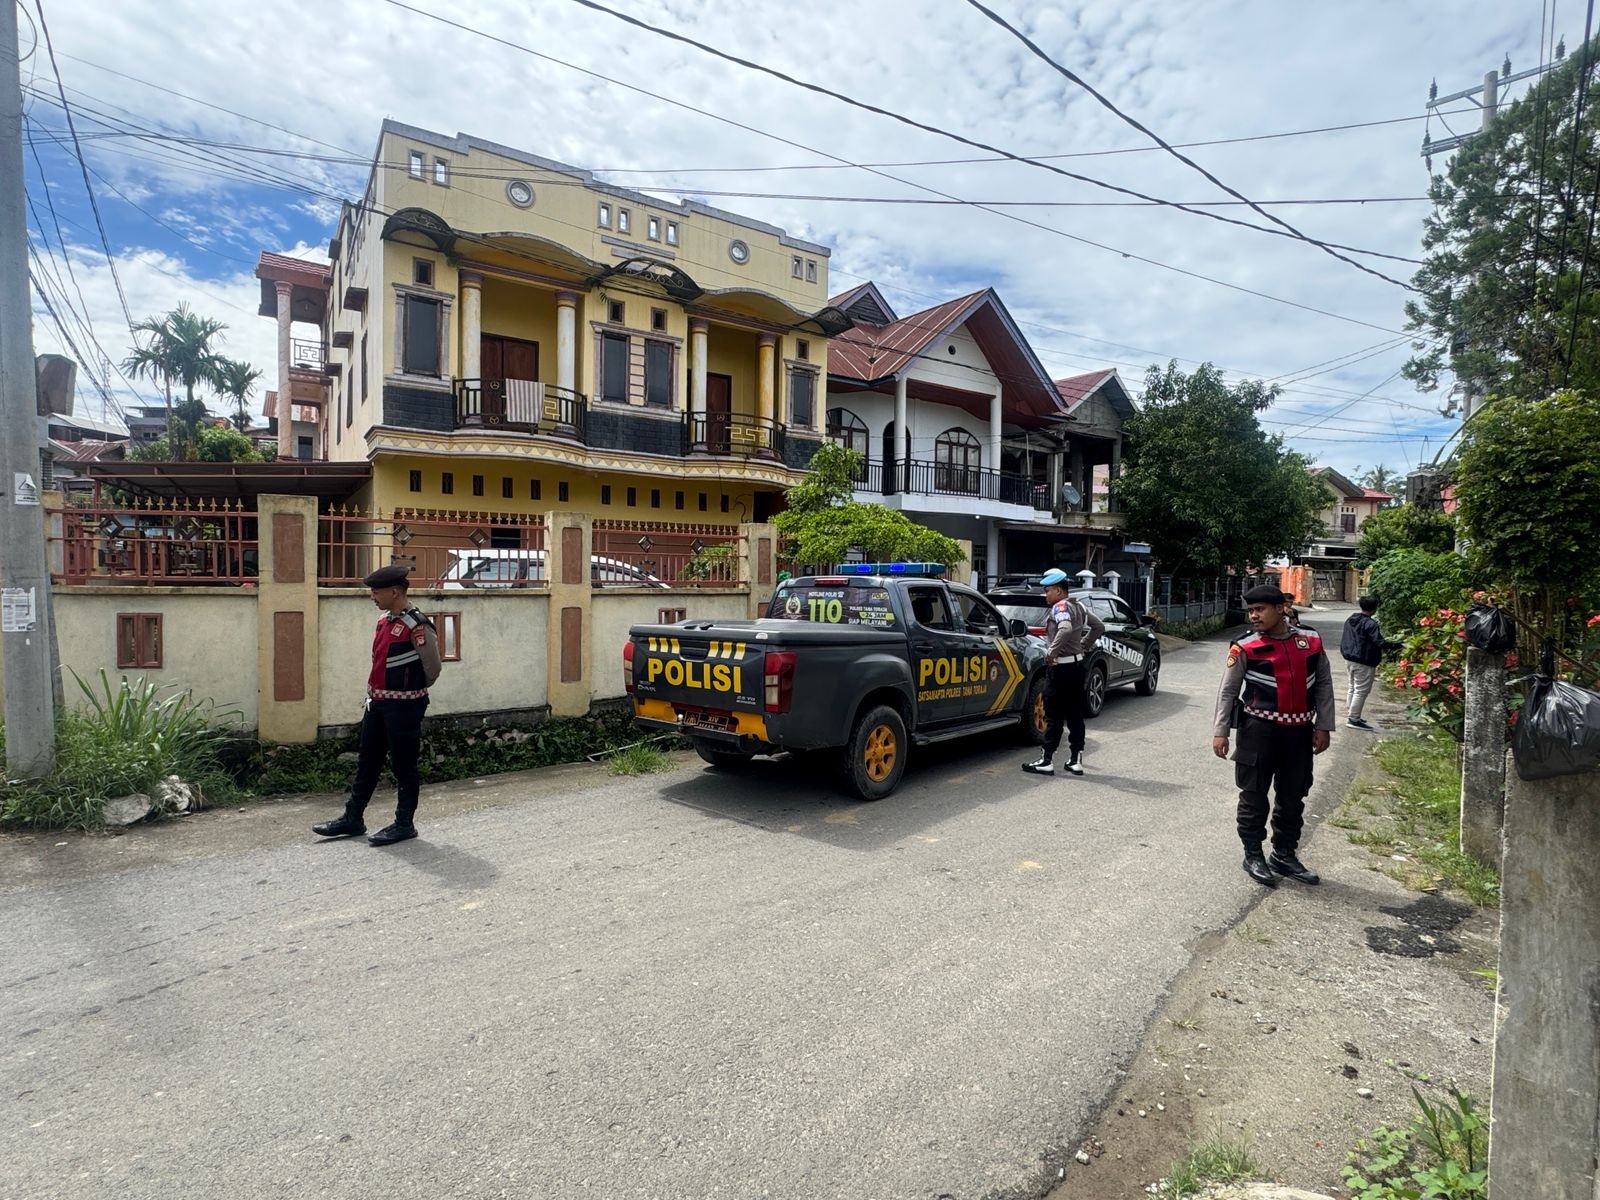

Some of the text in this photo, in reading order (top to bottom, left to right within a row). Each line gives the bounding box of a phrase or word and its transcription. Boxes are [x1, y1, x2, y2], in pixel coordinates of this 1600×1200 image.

[808, 599, 842, 624] 110
[648, 658, 742, 693] POLISI
[919, 656, 987, 687] POLISI
